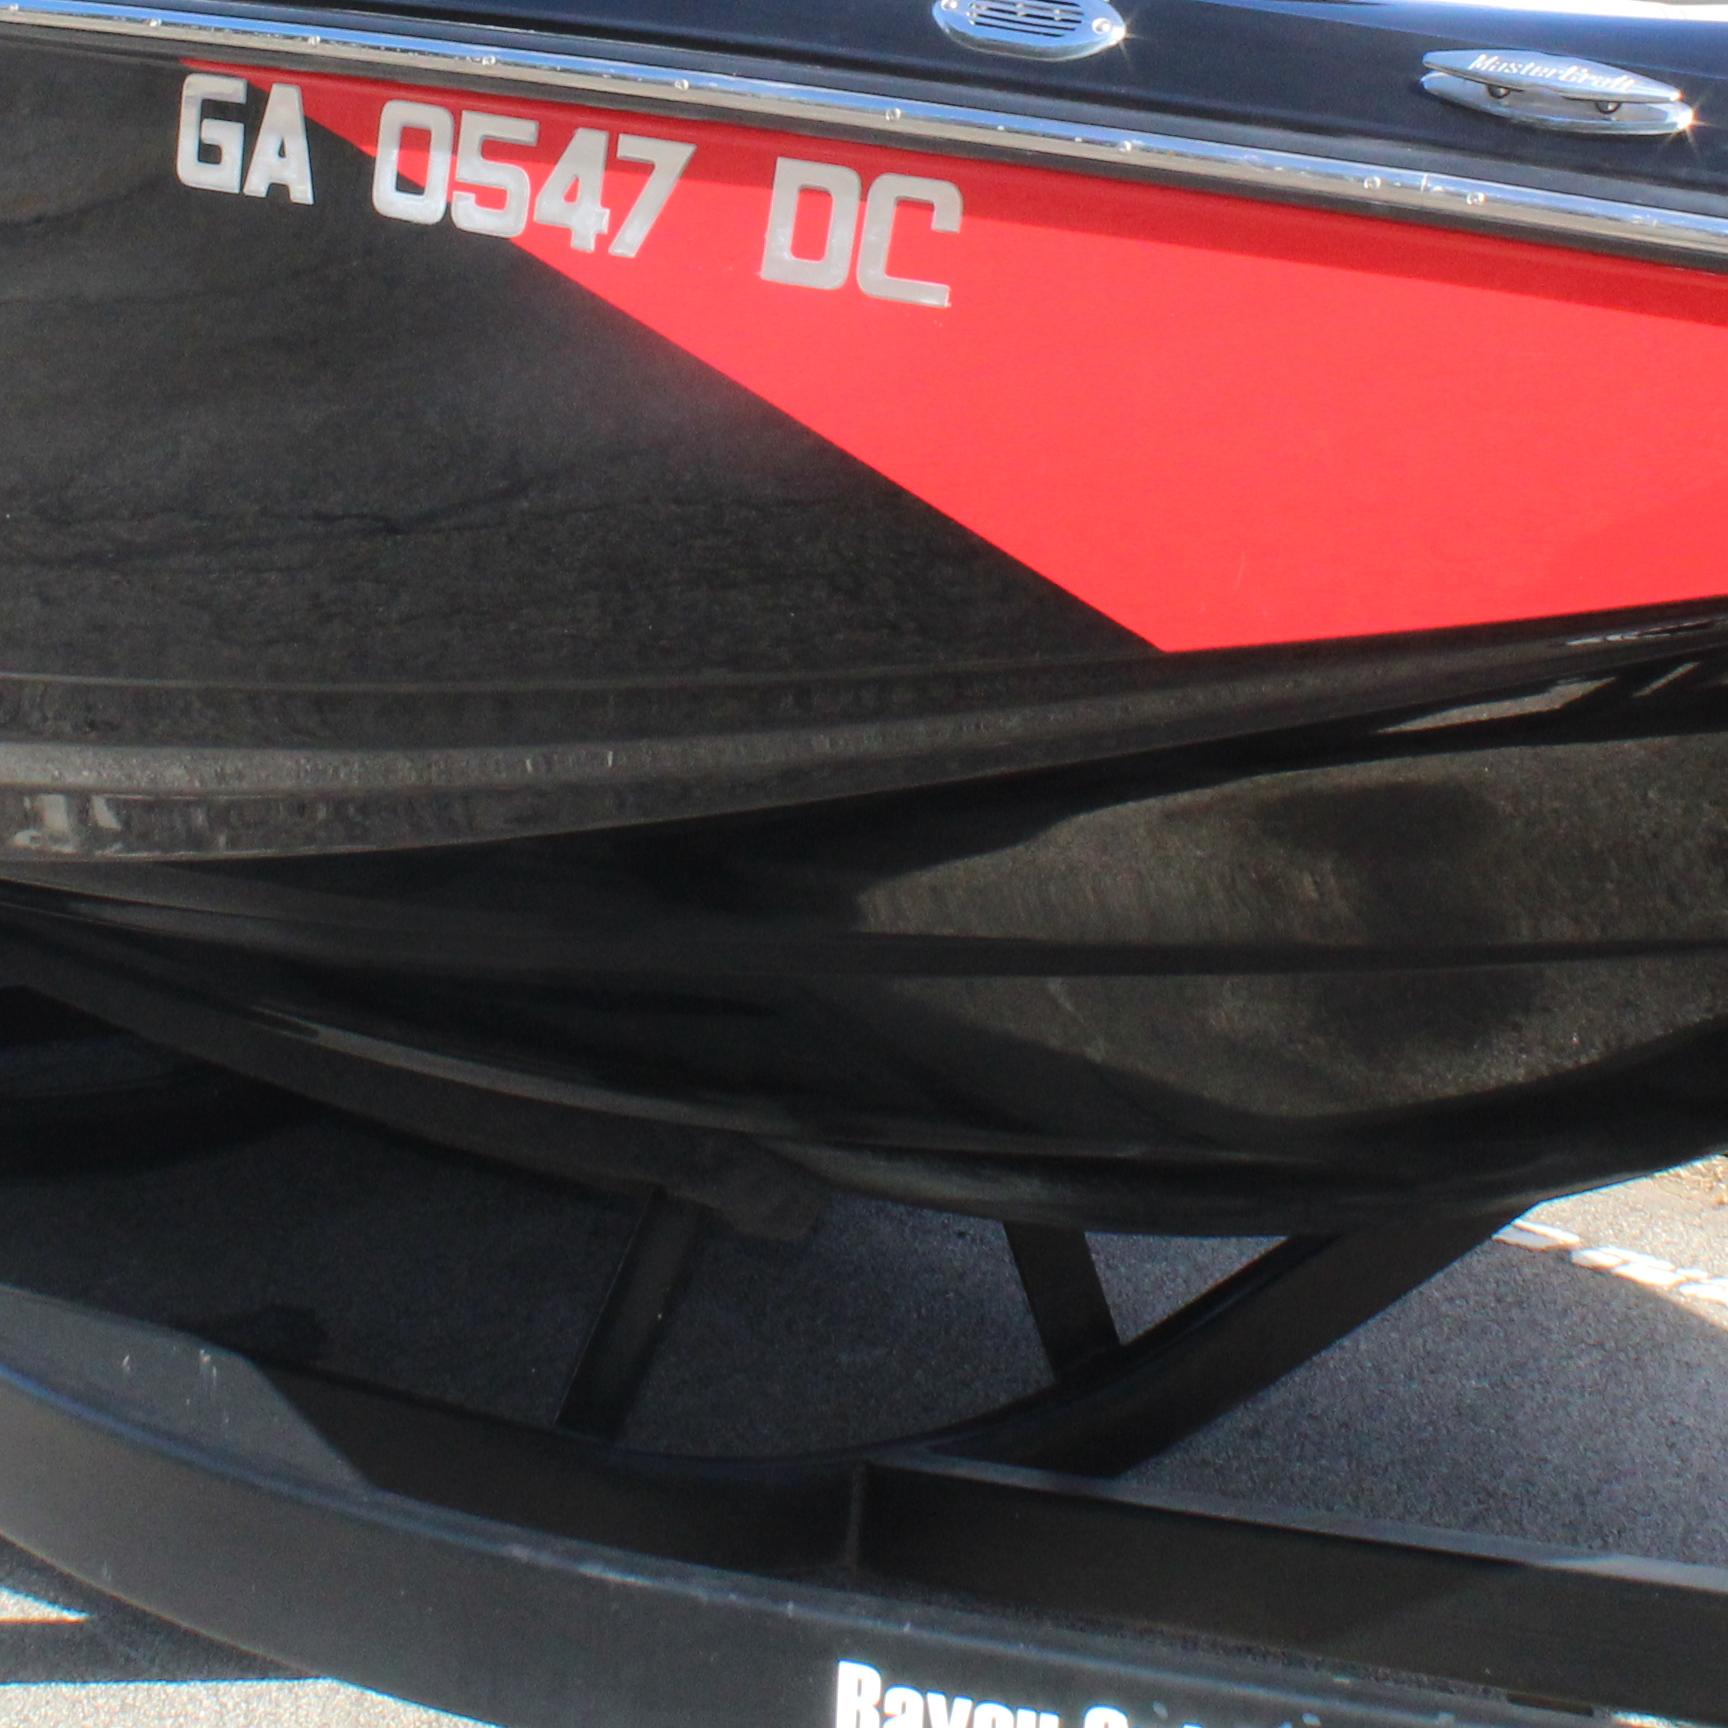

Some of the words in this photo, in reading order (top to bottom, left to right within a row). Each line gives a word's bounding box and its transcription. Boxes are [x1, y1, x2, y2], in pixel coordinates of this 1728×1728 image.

[176, 73, 314, 206] GA
[372, 99, 697, 258] 0547
[759, 156, 963, 308] DC
